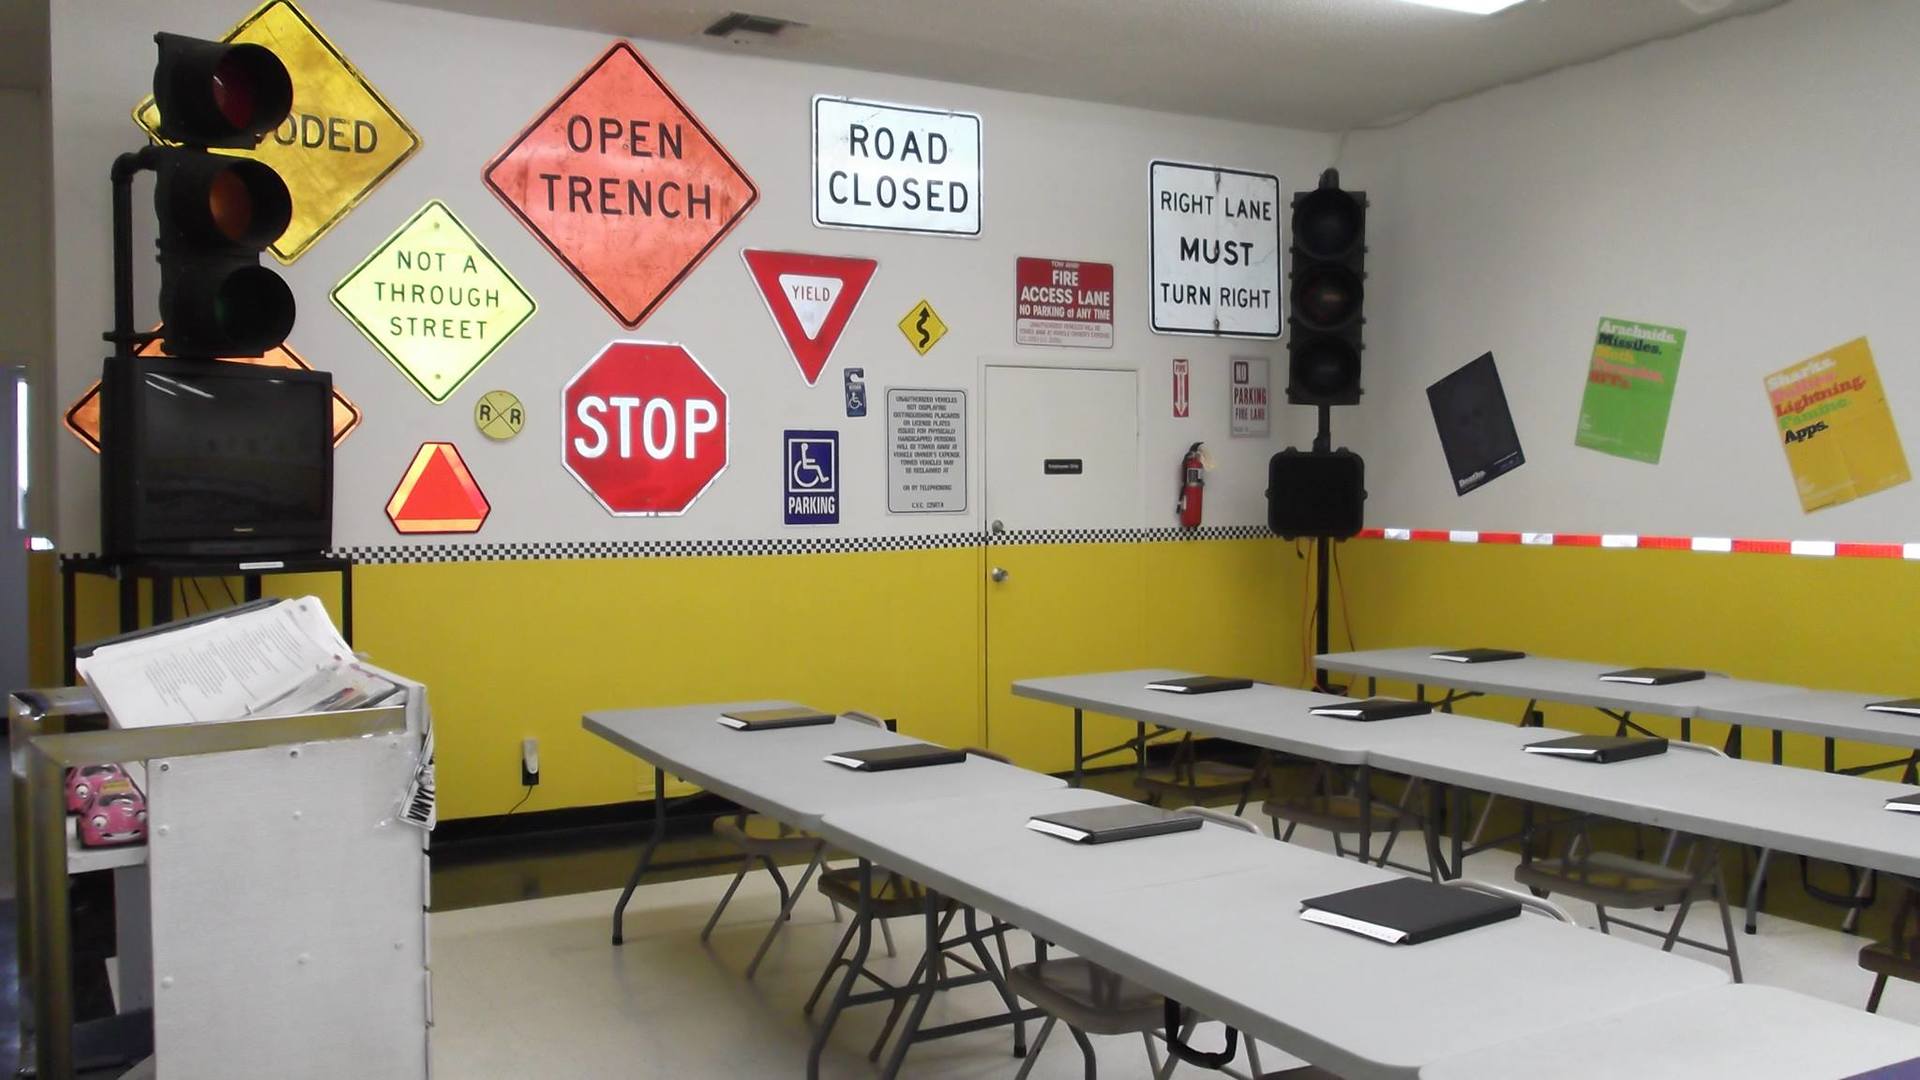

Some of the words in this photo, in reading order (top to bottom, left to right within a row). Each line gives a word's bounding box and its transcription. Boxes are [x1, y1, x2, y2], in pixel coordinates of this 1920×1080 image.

[273, 113, 378, 153] ODED
[567, 115, 683, 160] OPEN
[850, 123, 947, 164] ROAD
[539, 173, 711, 220] TRENCH
[829, 170, 968, 213] CLOSED
[1161, 190, 1214, 215] RIGHT
[1225, 197, 1272, 221] LANE
[397, 250, 446, 272] NOT
[463, 255, 478, 274] A
[1181, 236, 1253, 266] MUST
[1052, 270, 1079, 286] FIRE
[374, 281, 499, 308] THROUGH
[792, 285, 830, 302] YIELD
[1021, 286, 1073, 304] ACCESS
[1078, 290, 1110, 307] LANE
[1160, 283, 1211, 306] TURN
[1220, 287, 1271, 309] RIGHT
[1019, 304, 1031, 316] NO
[1033, 305, 1065, 318] PARKING
[1076, 307, 1092, 320] ANY
[1094, 308, 1110, 320] TIME
[390, 316, 487, 340] STREET
[1235, 363, 1246, 381] NO
[1234, 387, 1267, 405] PARKING
[480, 404, 491, 421] R
[510, 408, 521, 425] R
[574, 395, 718, 460] STOP
[1785, 421, 1829, 444] Apps.
[788, 496, 835, 515] PARKING
